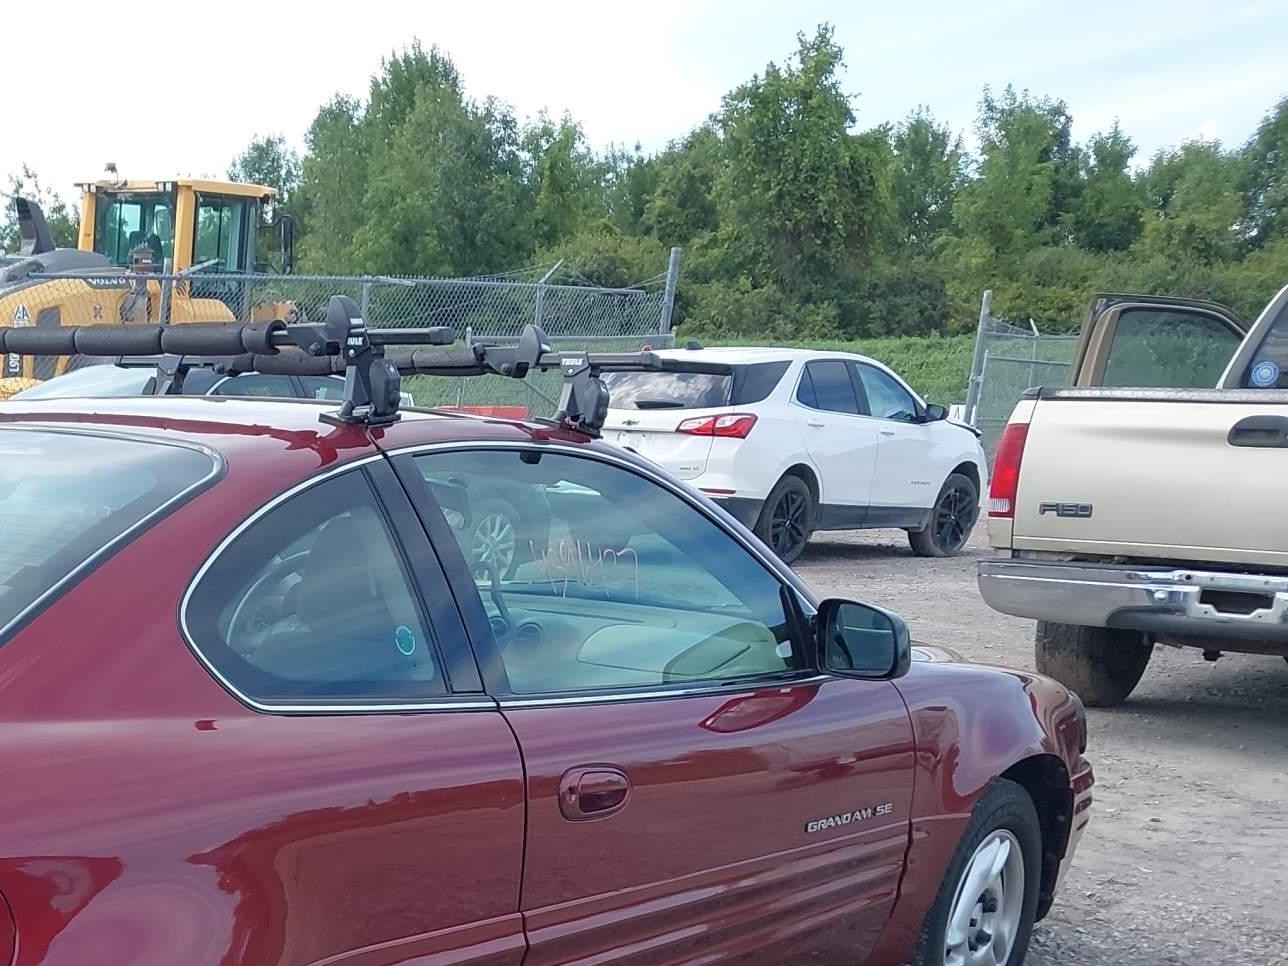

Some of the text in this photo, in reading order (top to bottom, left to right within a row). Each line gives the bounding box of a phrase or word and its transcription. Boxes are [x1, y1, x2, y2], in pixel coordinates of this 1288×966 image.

[804, 802, 893, 833] GRAND AM SE
